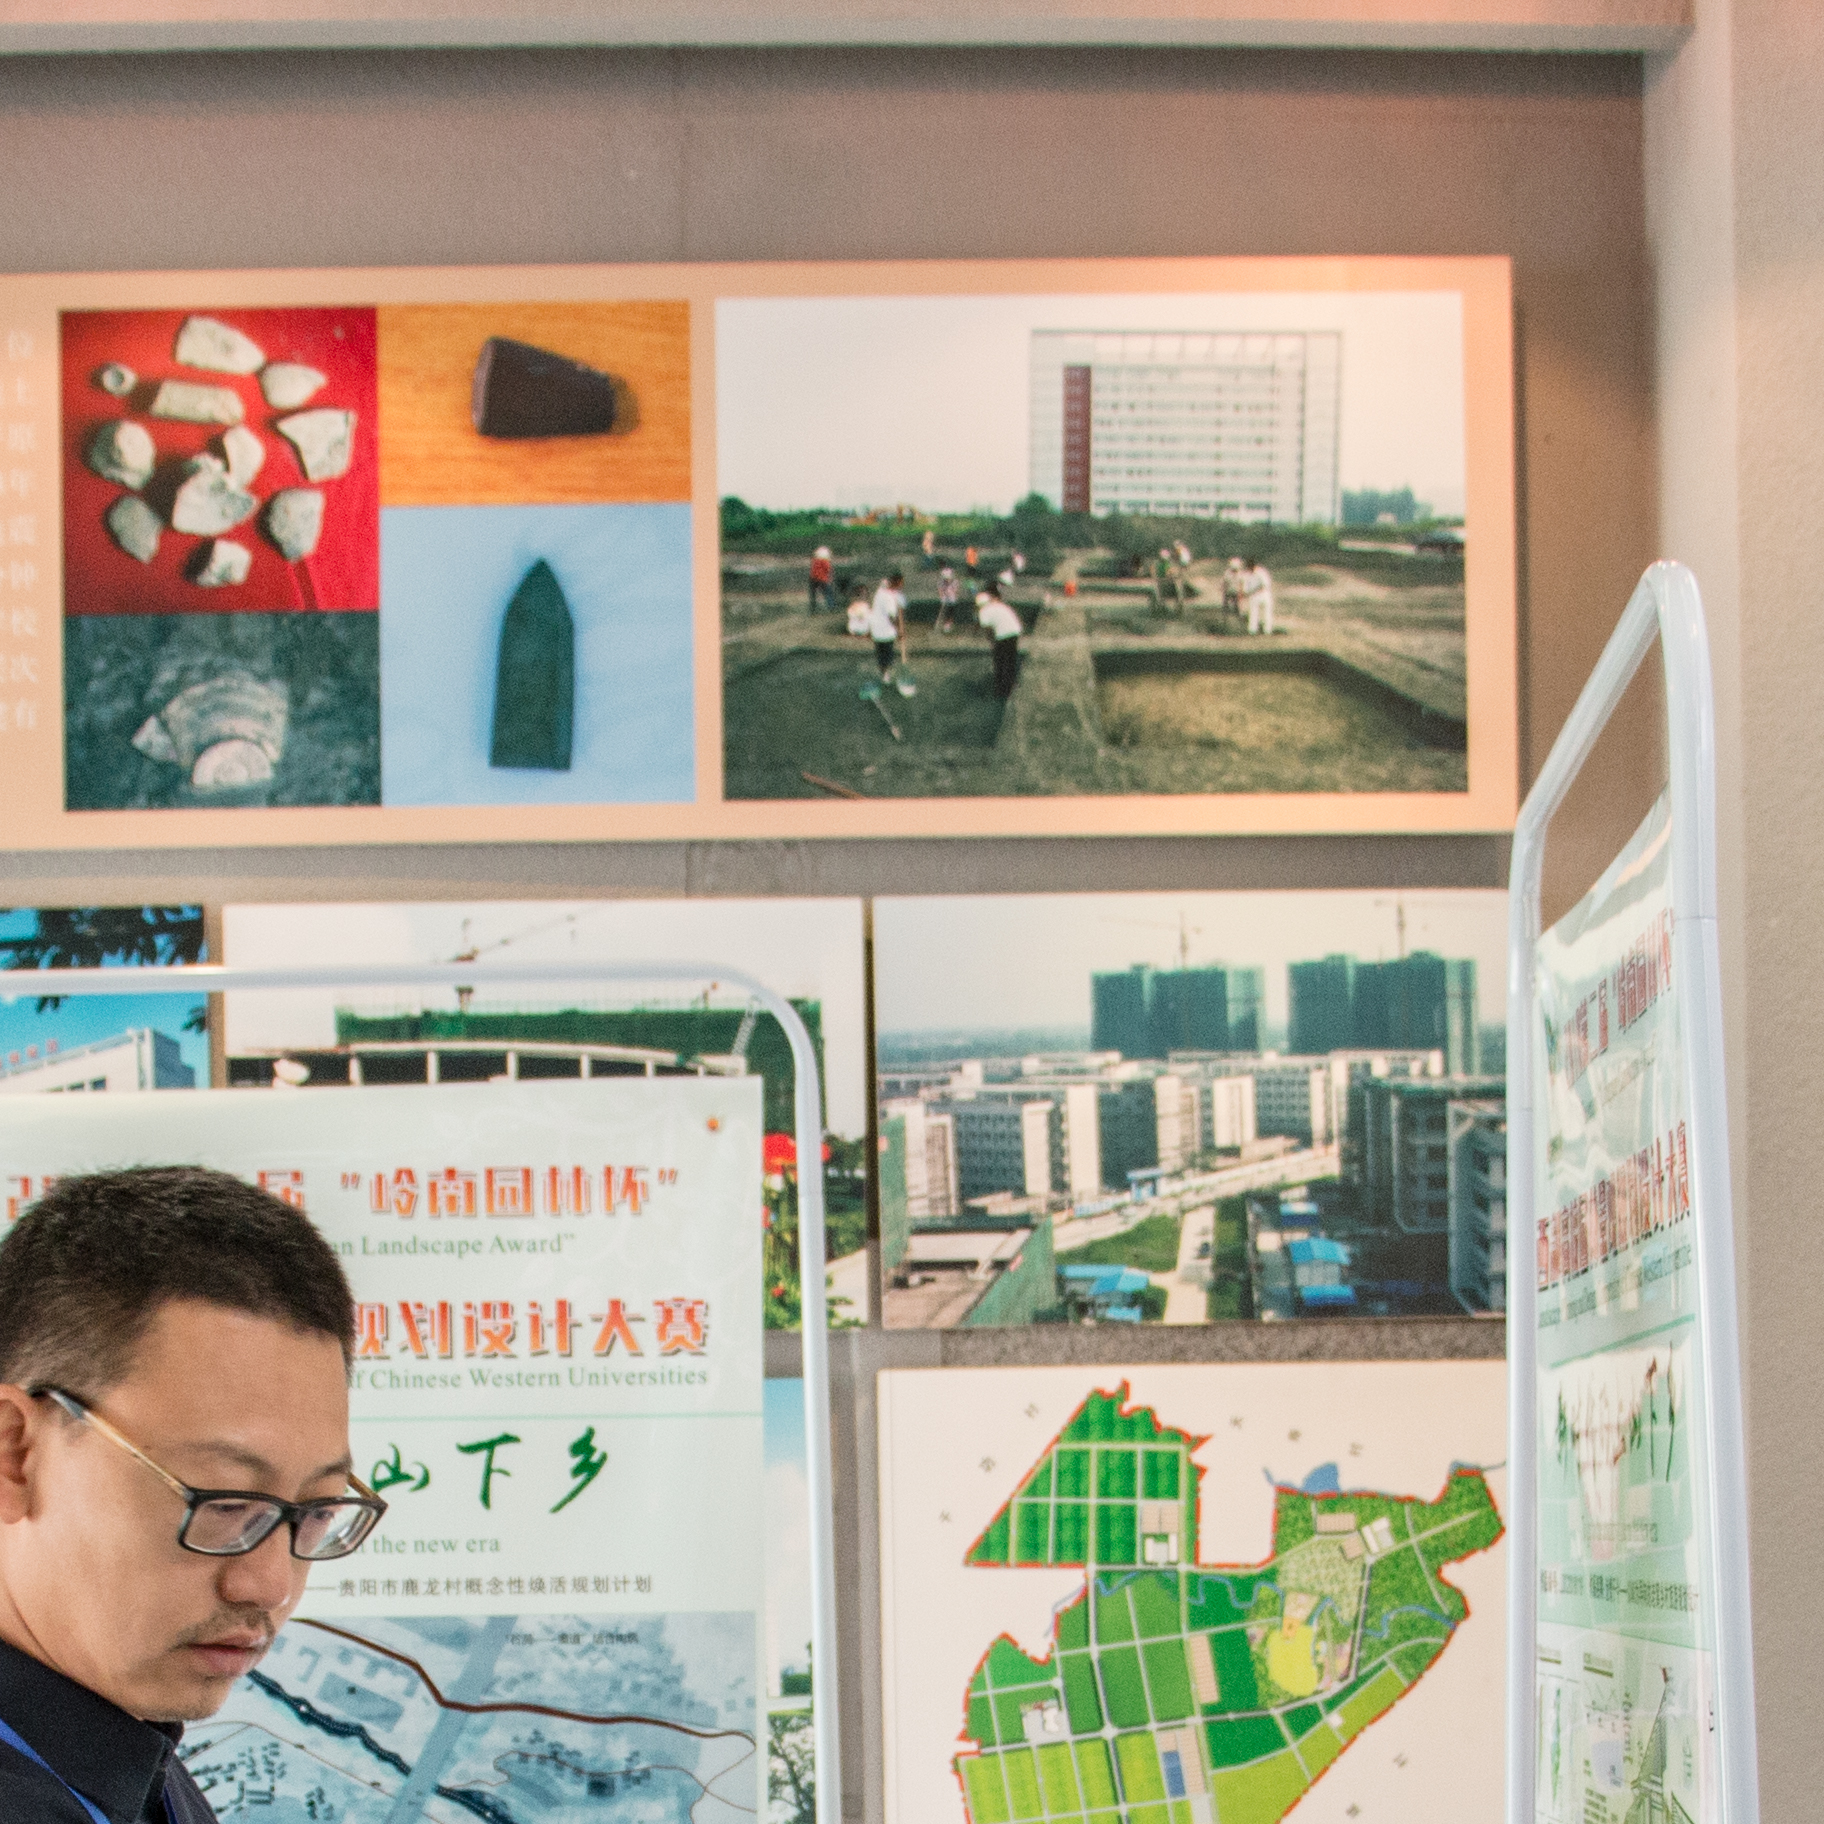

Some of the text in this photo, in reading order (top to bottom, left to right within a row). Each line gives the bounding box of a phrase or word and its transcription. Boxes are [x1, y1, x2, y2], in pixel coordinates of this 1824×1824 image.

[360, 1234, 484, 1259] Landscape
[369, 1366, 709, 1390] Chinese Western Universities
[372, 1533, 408, 1555] the
[413, 1538, 459, 1555] new
[465, 1537, 502, 1554] era
